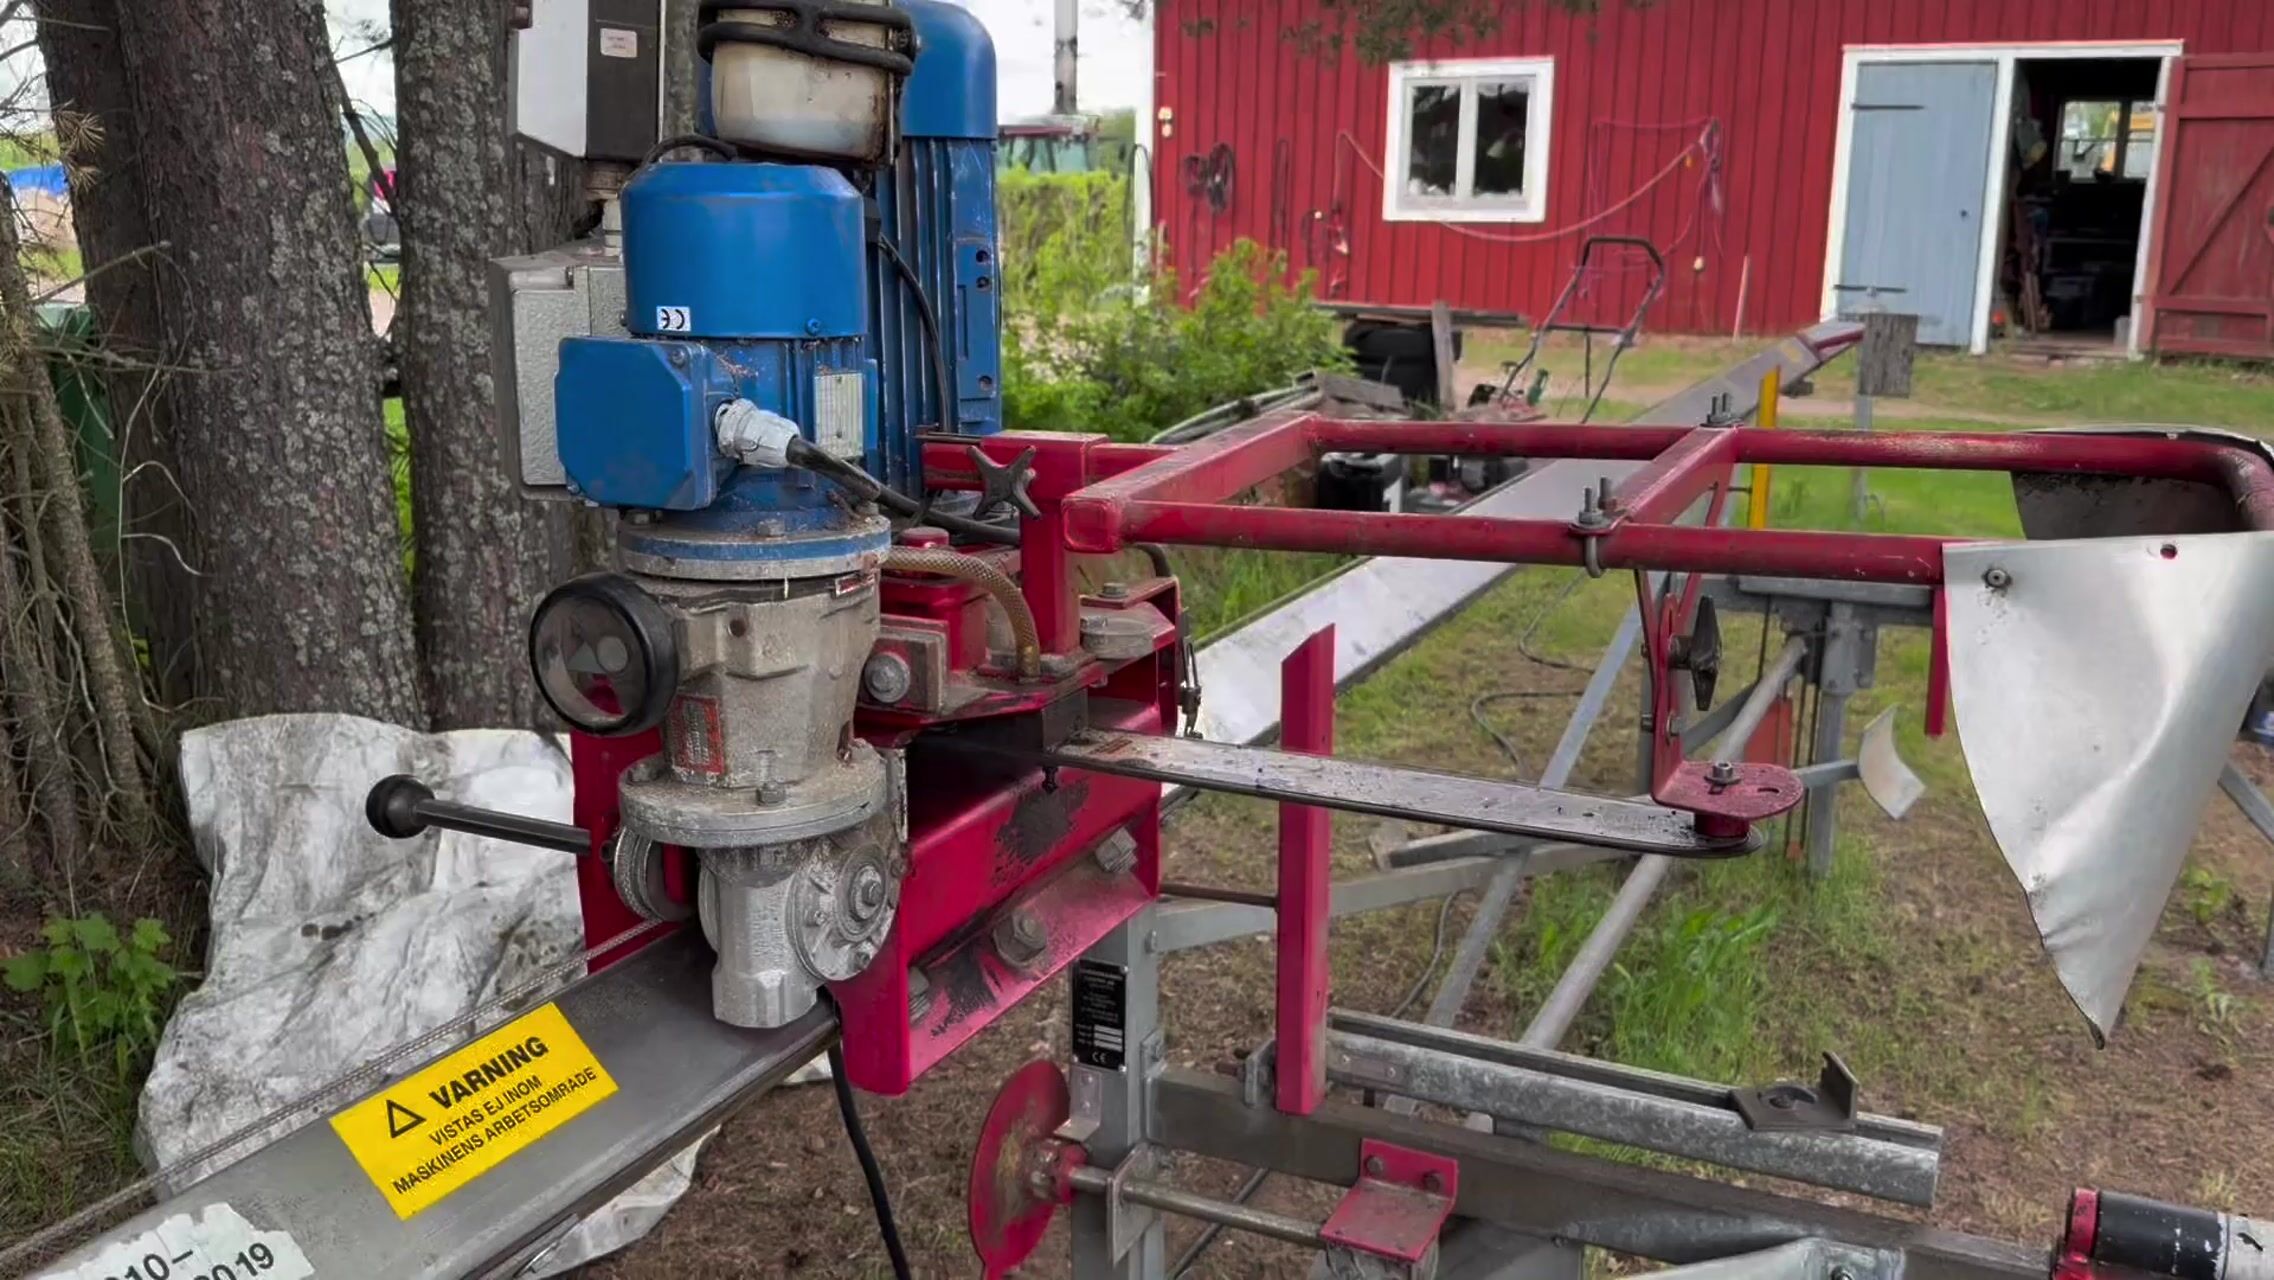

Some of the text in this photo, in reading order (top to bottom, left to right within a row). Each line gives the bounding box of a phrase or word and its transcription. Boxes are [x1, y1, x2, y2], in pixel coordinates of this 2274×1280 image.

[661, 308, 685, 330] CE
[428, 1036, 549, 1110] VARNING
[428, 1074, 543, 1146] VISTAS EJ INOM
[391, 1134, 485, 1195] MASKINENS
